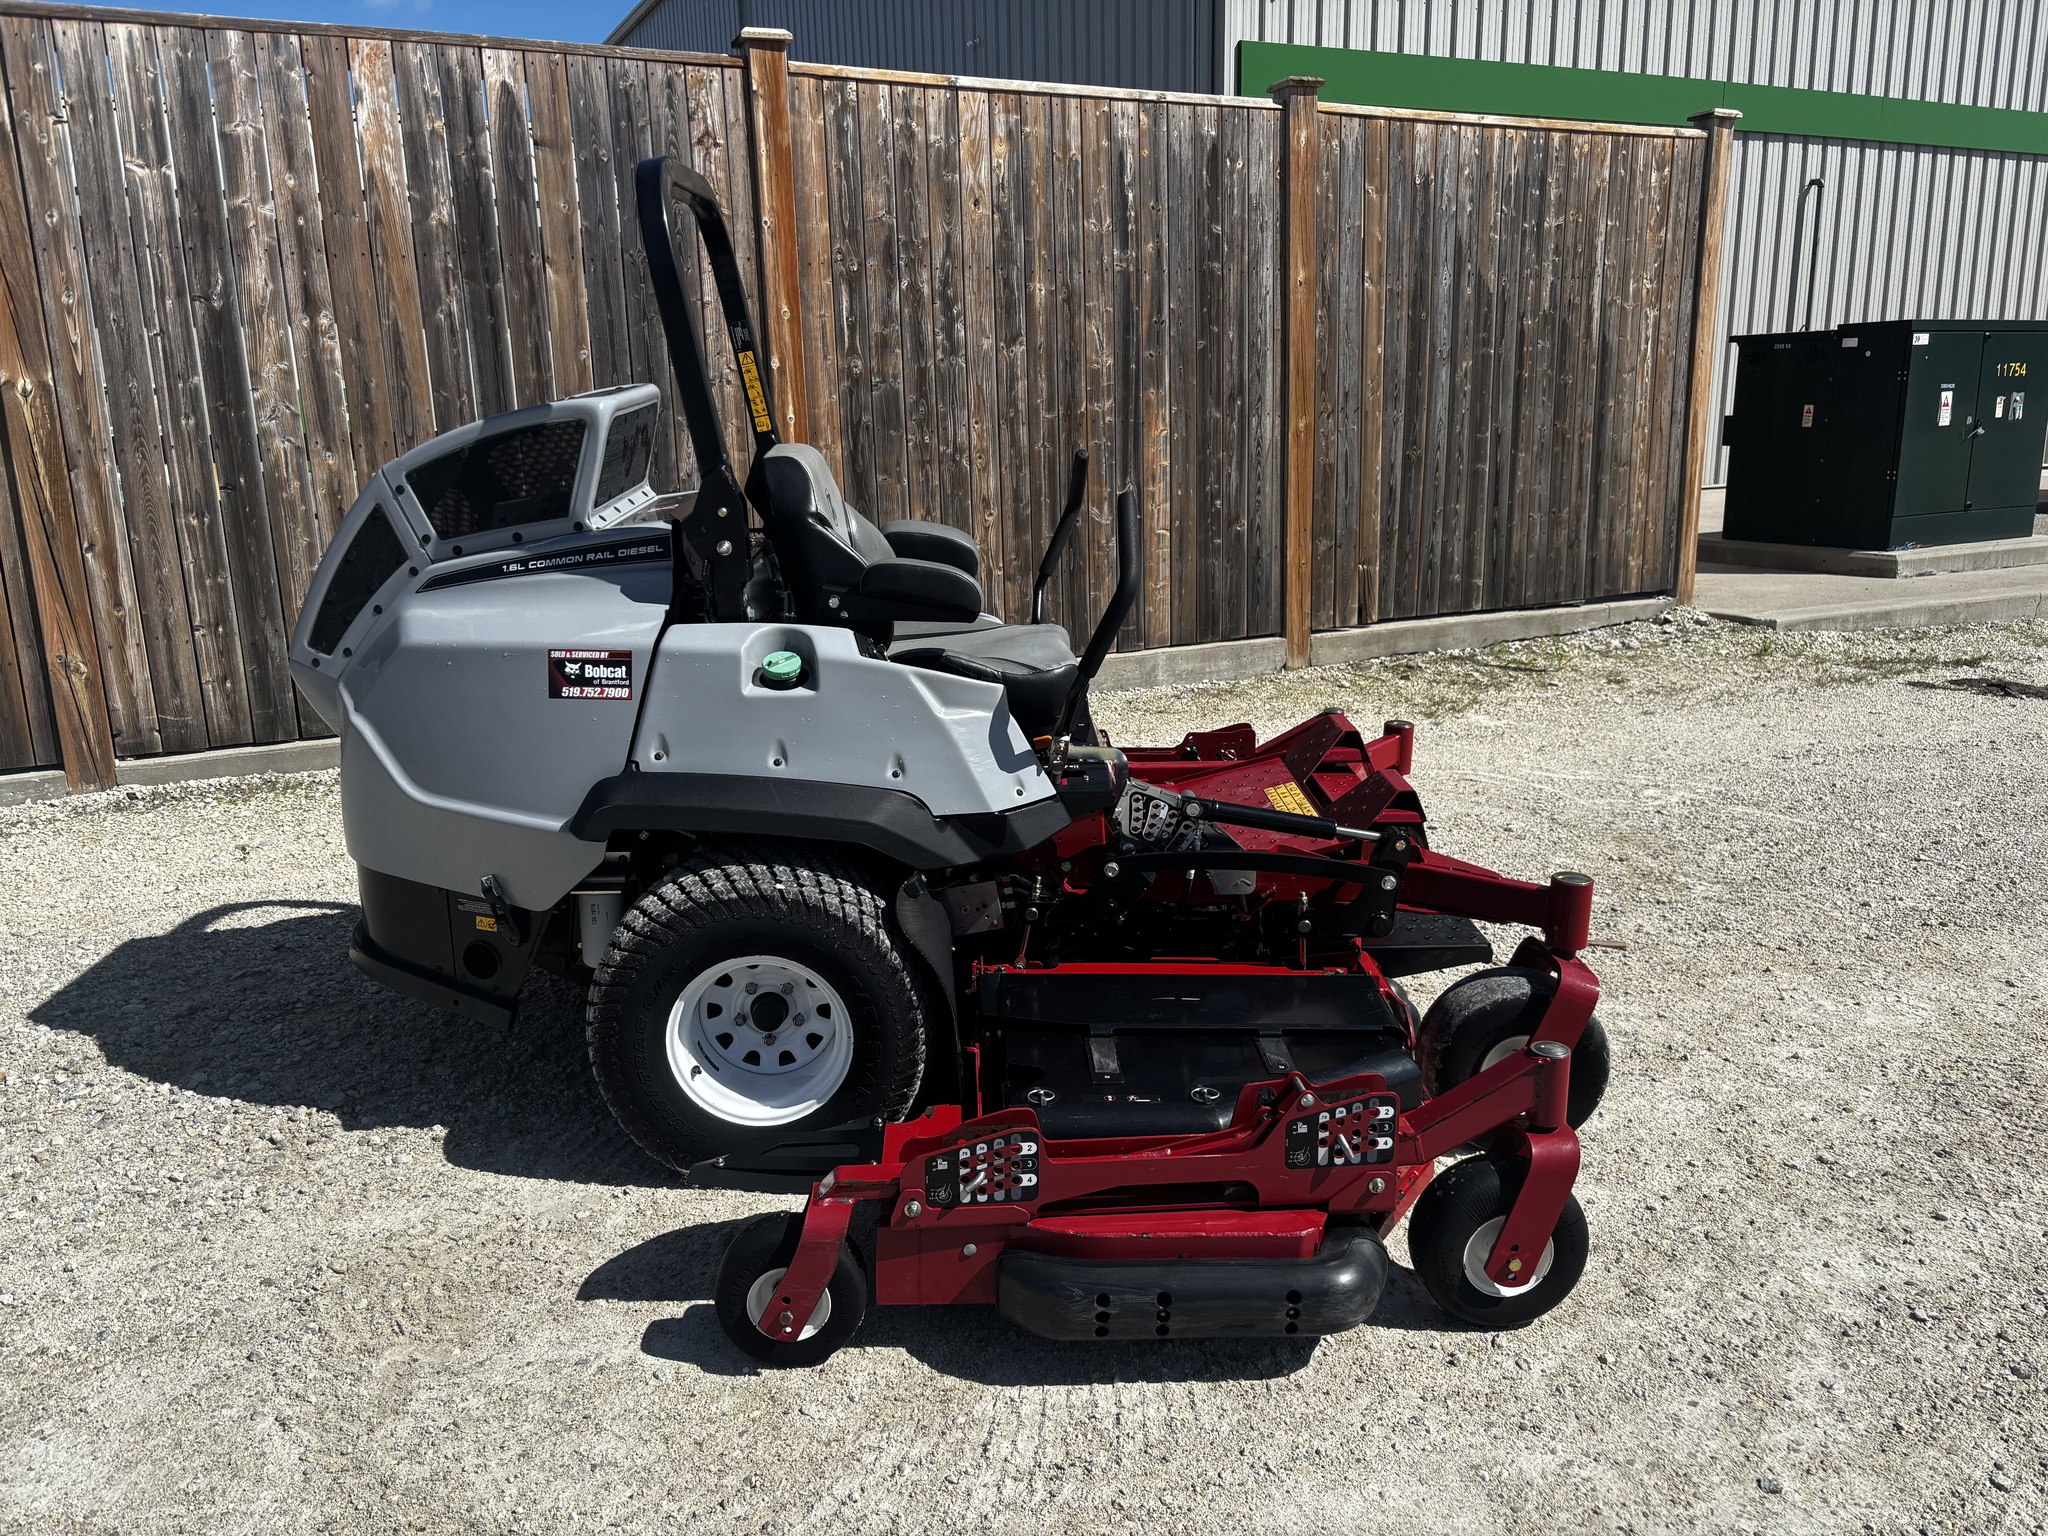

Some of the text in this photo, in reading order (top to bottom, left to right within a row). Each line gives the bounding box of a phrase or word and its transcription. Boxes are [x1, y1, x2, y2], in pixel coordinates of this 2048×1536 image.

[1996, 362, 2027, 377] 11754
[502, 545, 663, 573] 1.6L COMMON RAIL DIESEL
[584, 664, 626, 678] Bobcat
[561, 687, 629, 698] 519.752.7900
[645, 1089, 707, 1144] MULTI
